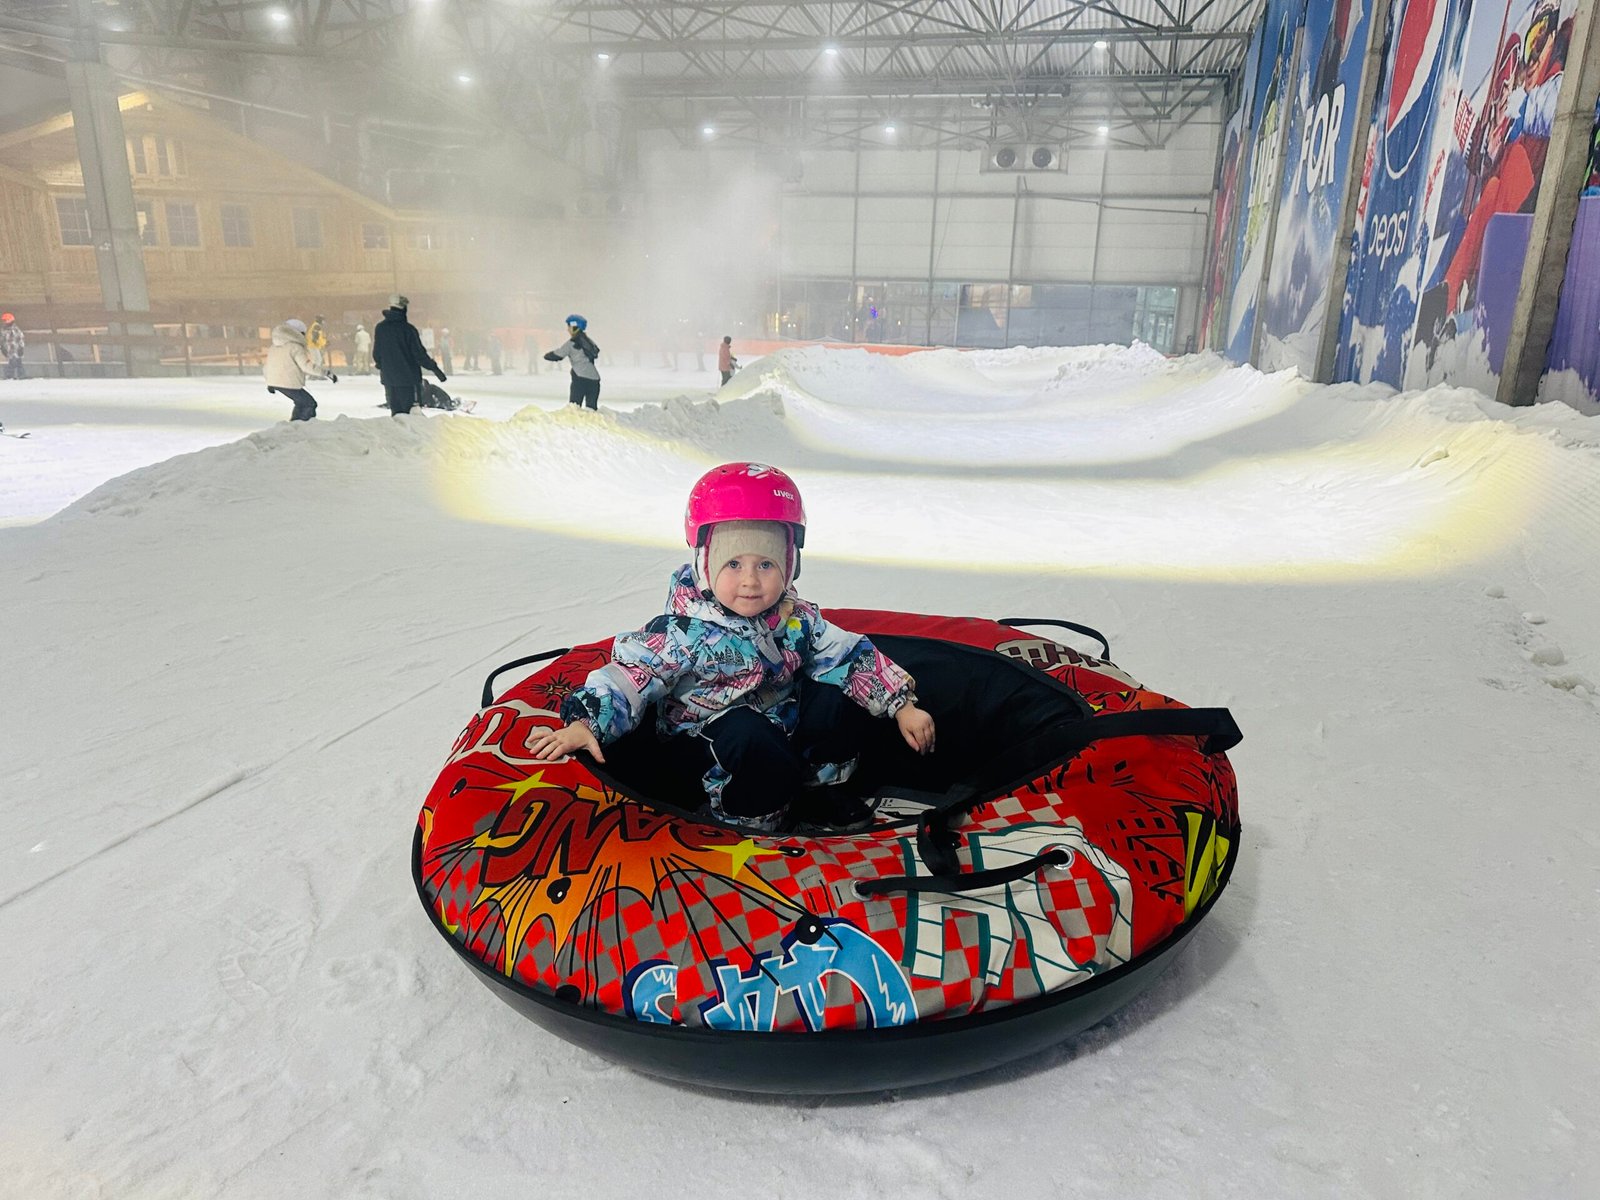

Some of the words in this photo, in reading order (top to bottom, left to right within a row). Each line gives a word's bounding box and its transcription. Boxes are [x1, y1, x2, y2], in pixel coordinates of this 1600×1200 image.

[1295, 83, 1345, 195] FOR
[1368, 195, 1412, 272] pepsi
[773, 489, 795, 501] uvex
